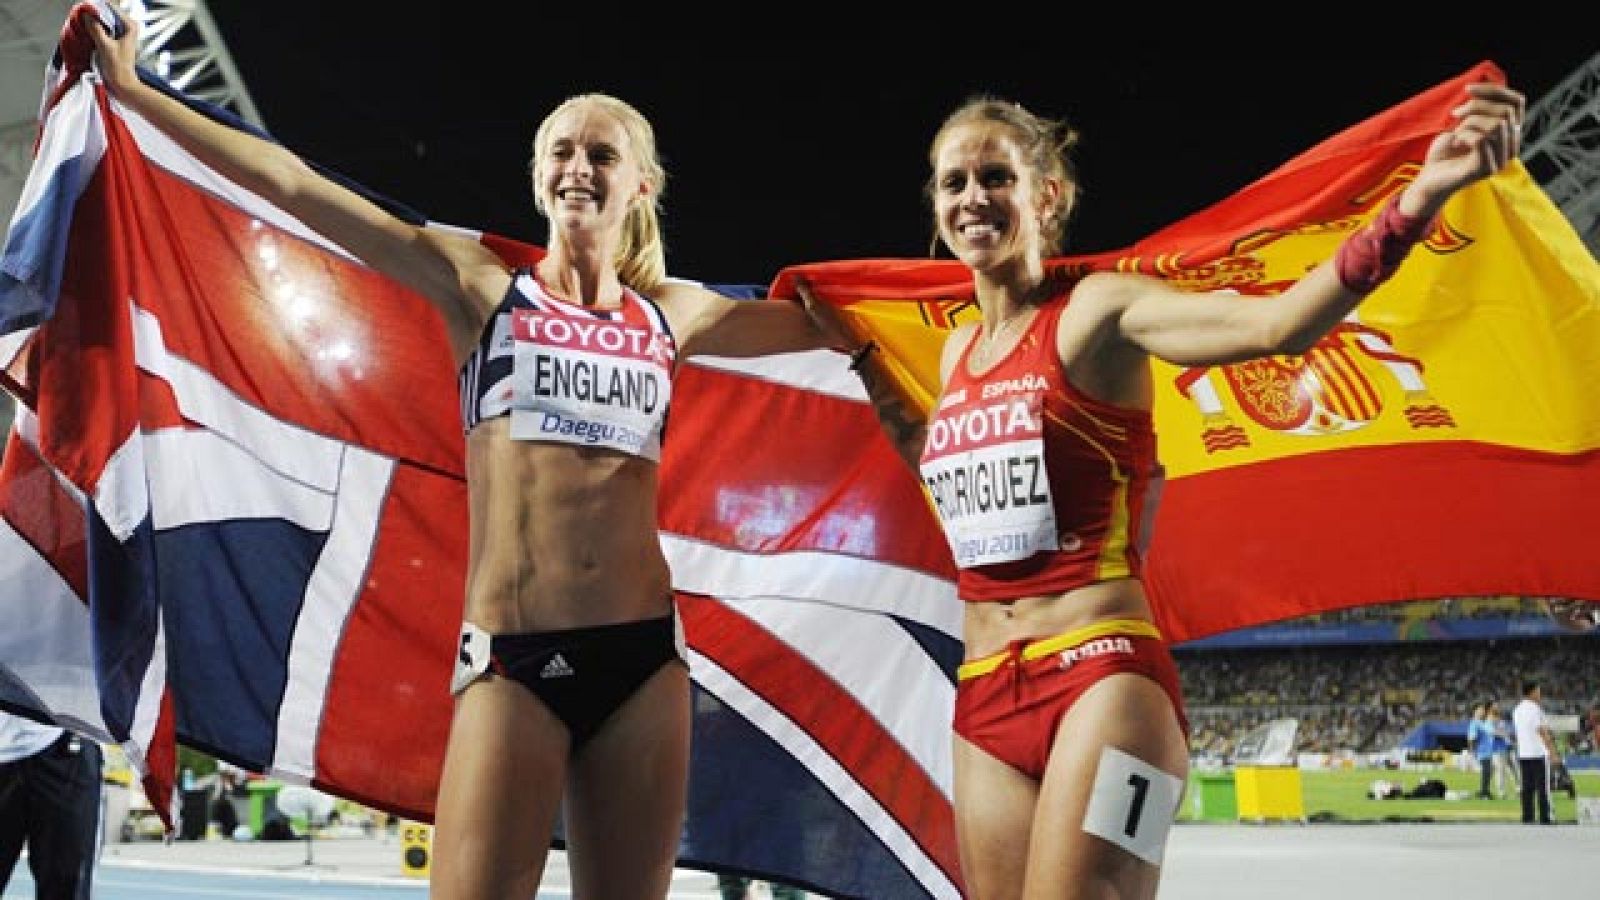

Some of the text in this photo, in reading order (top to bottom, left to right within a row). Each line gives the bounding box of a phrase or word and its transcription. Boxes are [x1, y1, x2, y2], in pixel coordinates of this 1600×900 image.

[518, 314, 668, 360] TOYOTA
[534, 354, 658, 415] ENGLAND
[982, 374, 1049, 399] ESPAÑA
[541, 411, 615, 442] Daegu
[989, 532, 1029, 554] 2011
[1124, 773, 1150, 838] 1
